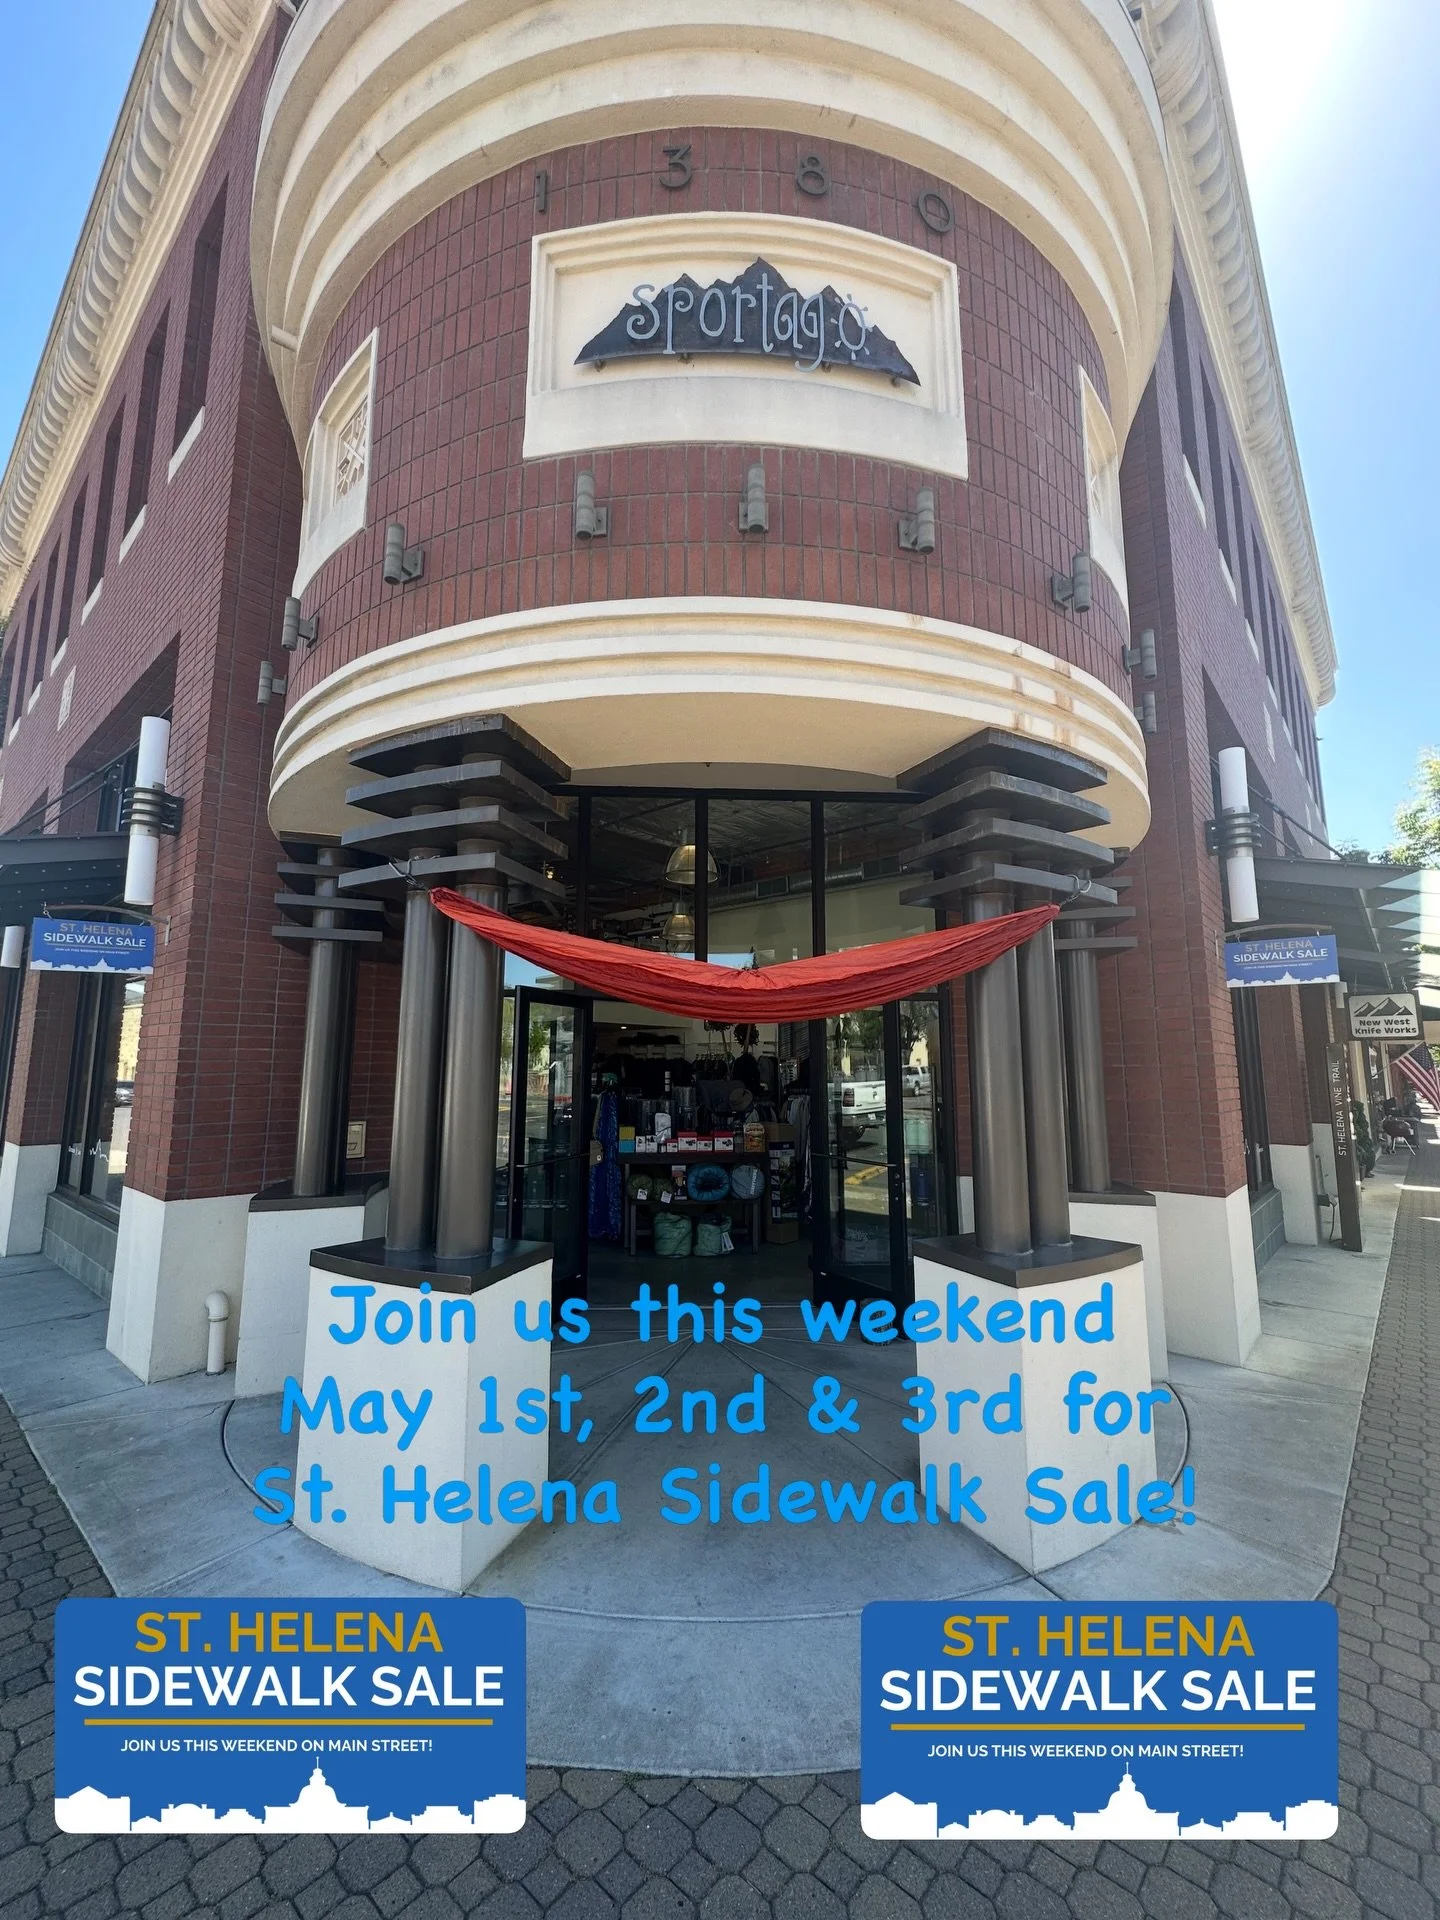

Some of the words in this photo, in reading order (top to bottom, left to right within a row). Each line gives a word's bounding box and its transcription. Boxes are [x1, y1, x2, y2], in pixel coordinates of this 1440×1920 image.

[60, 922, 80, 933] ST.
[83, 924, 133, 937] HELENA
[43, 932, 113, 946] SIDEWALK
[116, 937, 147, 948] SALE
[1265, 939, 1314, 951] HELENA
[1233, 950, 1295, 963] SIDEWALK
[1297, 948, 1329, 959] SALE
[1384, 1018, 1411, 1026] West
[1355, 1027, 1382, 1035] Knife
[1384, 1026, 1417, 1034] Works
[1332, 1060, 1341, 1083] TRAIL
[1333, 1087, 1343, 1107] VINE
[1336, 1110, 1346, 1142] HELENA
[1338, 1143, 1347, 1156] ST.
